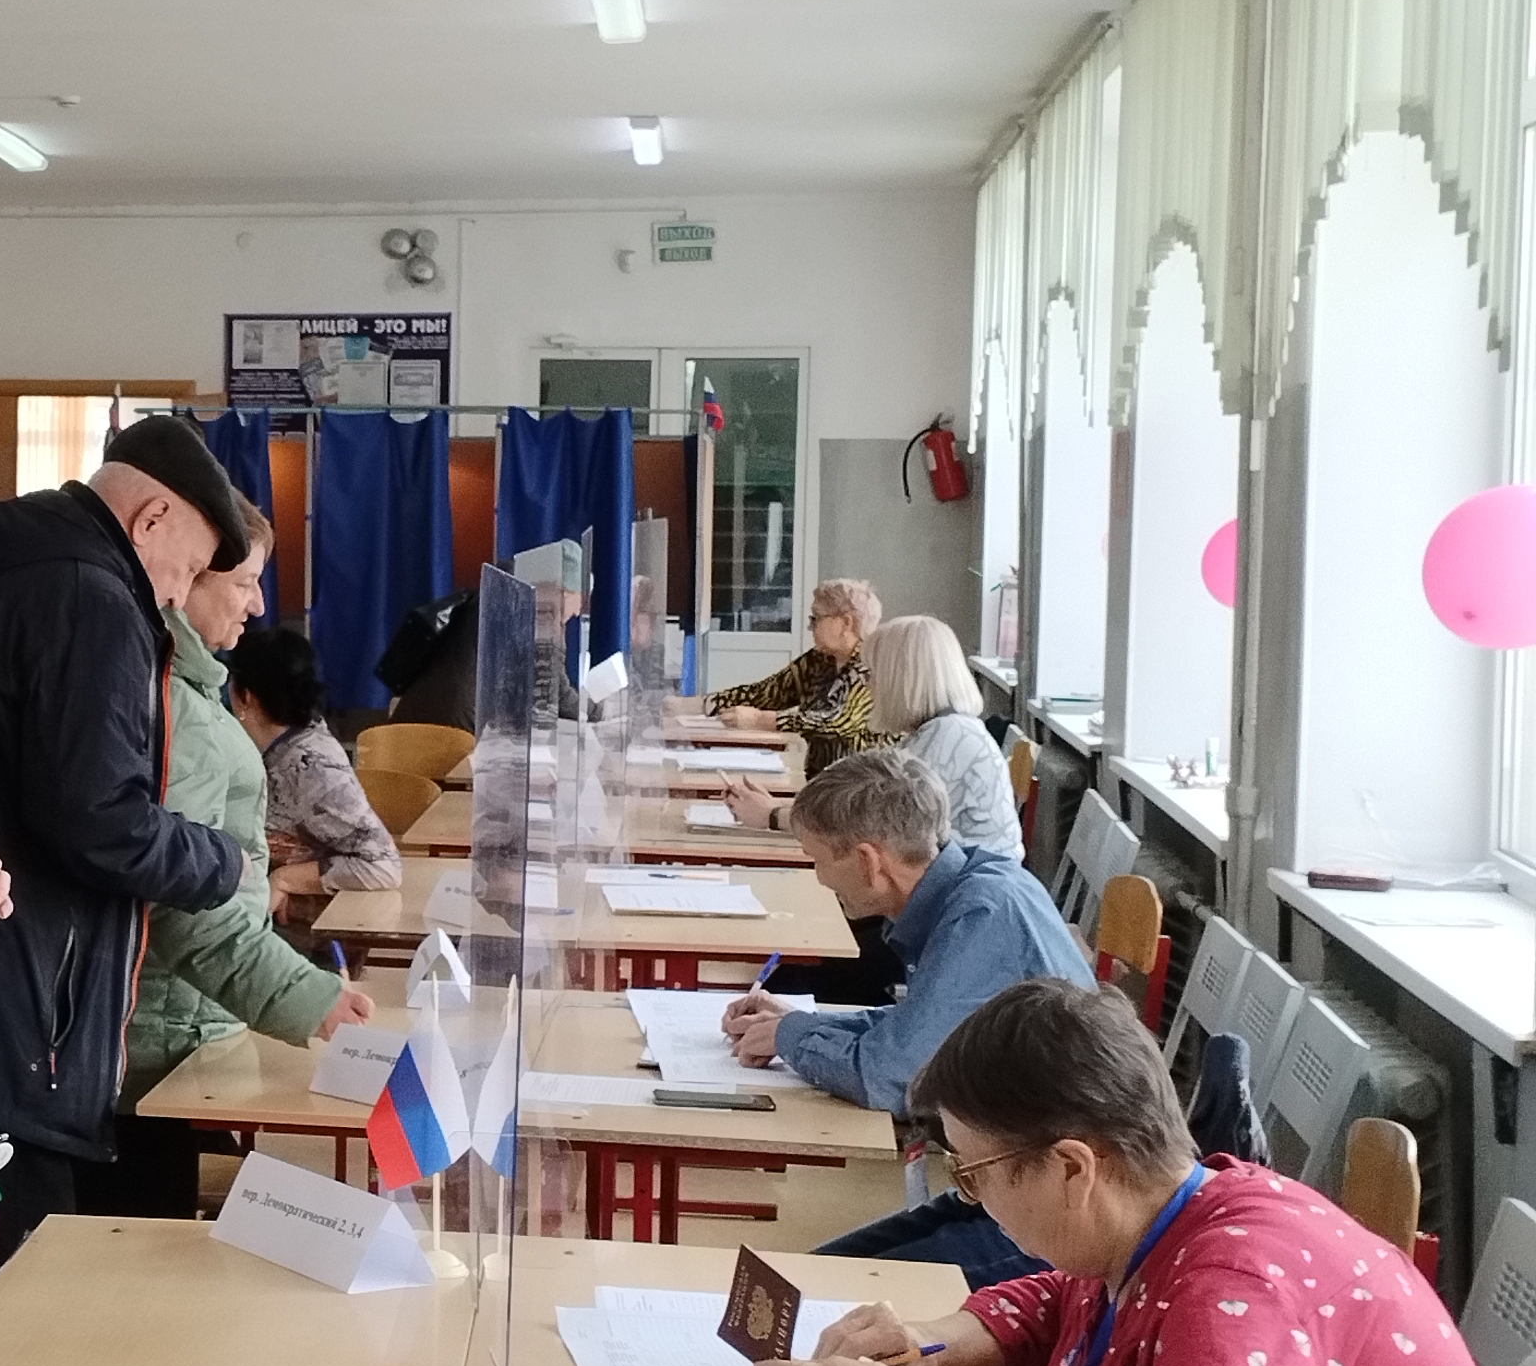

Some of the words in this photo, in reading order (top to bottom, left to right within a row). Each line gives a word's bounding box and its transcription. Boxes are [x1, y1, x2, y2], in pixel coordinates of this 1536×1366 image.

[300, 318, 359, 335] ЛИЦЕЙ
[374, 320, 407, 334] ЭТО
[411, 319, 447, 334] МЫ!
[241, 1187, 259, 1204] пер.
[259, 1192, 339, 1230] Демократический
[773, 1297, 792, 1360] АСПОРТ
